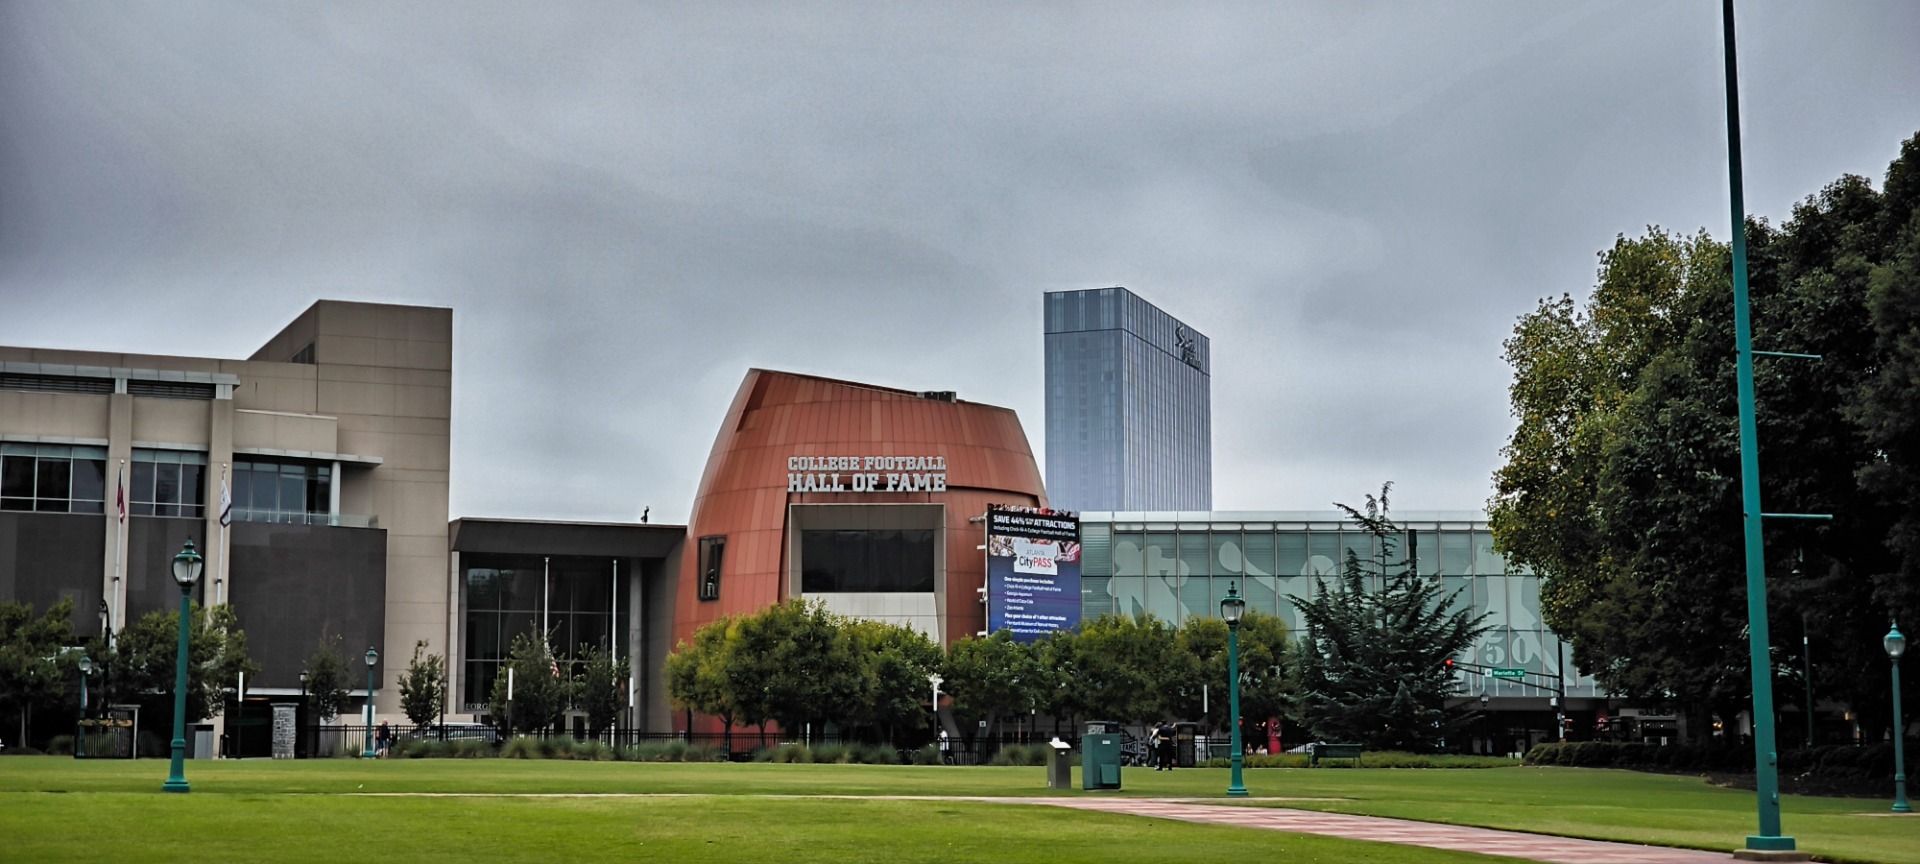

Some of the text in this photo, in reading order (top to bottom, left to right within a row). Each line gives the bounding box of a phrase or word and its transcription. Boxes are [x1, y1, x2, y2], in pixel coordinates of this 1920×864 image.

[788, 456, 946, 471] COLLEGE FOOTBALL
[787, 473, 946, 492] HALL OF FAME
[993, 514, 1010, 524] SAVE
[1011, 516, 1025, 525] 44%
[1034, 519, 1076, 530] ATTRACTIONS
[1019, 556, 1052, 569] CityPASS
[1486, 636, 1534, 664] 50
[465, 703, 489, 711] EORG
